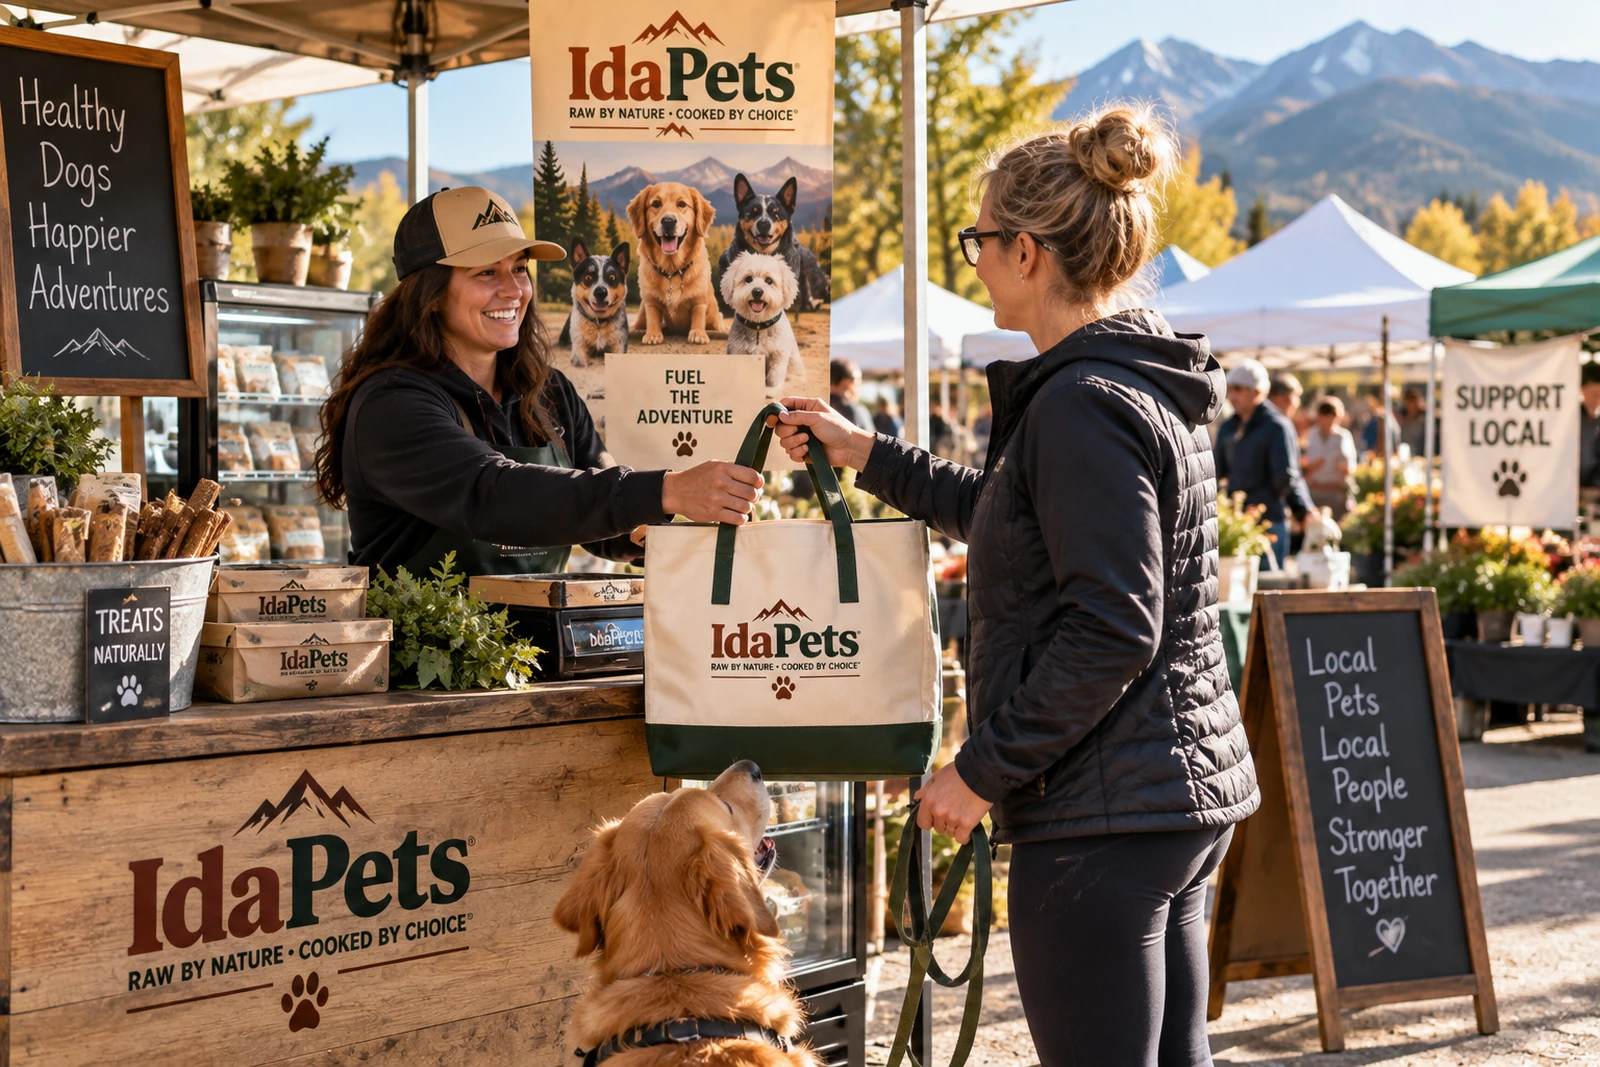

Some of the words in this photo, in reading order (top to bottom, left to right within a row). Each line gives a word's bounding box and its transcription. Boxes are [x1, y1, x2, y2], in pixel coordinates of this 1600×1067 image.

[19, 77, 126, 153] Healthy
[569, 107, 596, 119] RAW
[600, 108, 614, 119] BY
[619, 108, 665, 120] NATURE
[676, 109, 725, 120] COOKED
[729, 110, 744, 120] BY
[41, 141, 112, 208] Dogs
[29, 202, 136, 265] Happier
[29, 263, 169, 314] Adventures
[665, 370, 705, 385] FUEL
[670, 390, 700, 404] THE
[1456, 384, 1565, 411] SUPPORT
[637, 410, 733, 424] ADVENTURE
[1469, 420, 1551, 446] LOCAL
[95, 607, 164, 635] TREATS
[258, 595, 327, 616] IdaPets
[94, 643, 166, 665] NATURALLY
[280, 649, 348, 671] IdaPets
[711, 663, 728, 671] RAW
[731, 663, 741, 671] BY
[743, 663, 774, 671] NATURE
[781, 663, 814, 671] COOKED
[1306, 636, 1377, 676] Local
[1324, 681, 1380, 719] Pets
[1319, 723, 1390, 762] Local
[1332, 766, 1409, 814] People
[1328, 816, 1428, 862] Stronger
[1333, 864, 1438, 916] Together
[128, 964, 175, 991] RAW
[181, 959, 206, 982] BY
[211, 945, 284, 976] NATURE
[299, 930, 373, 960] COOKED
[378, 925, 401, 946] BY
